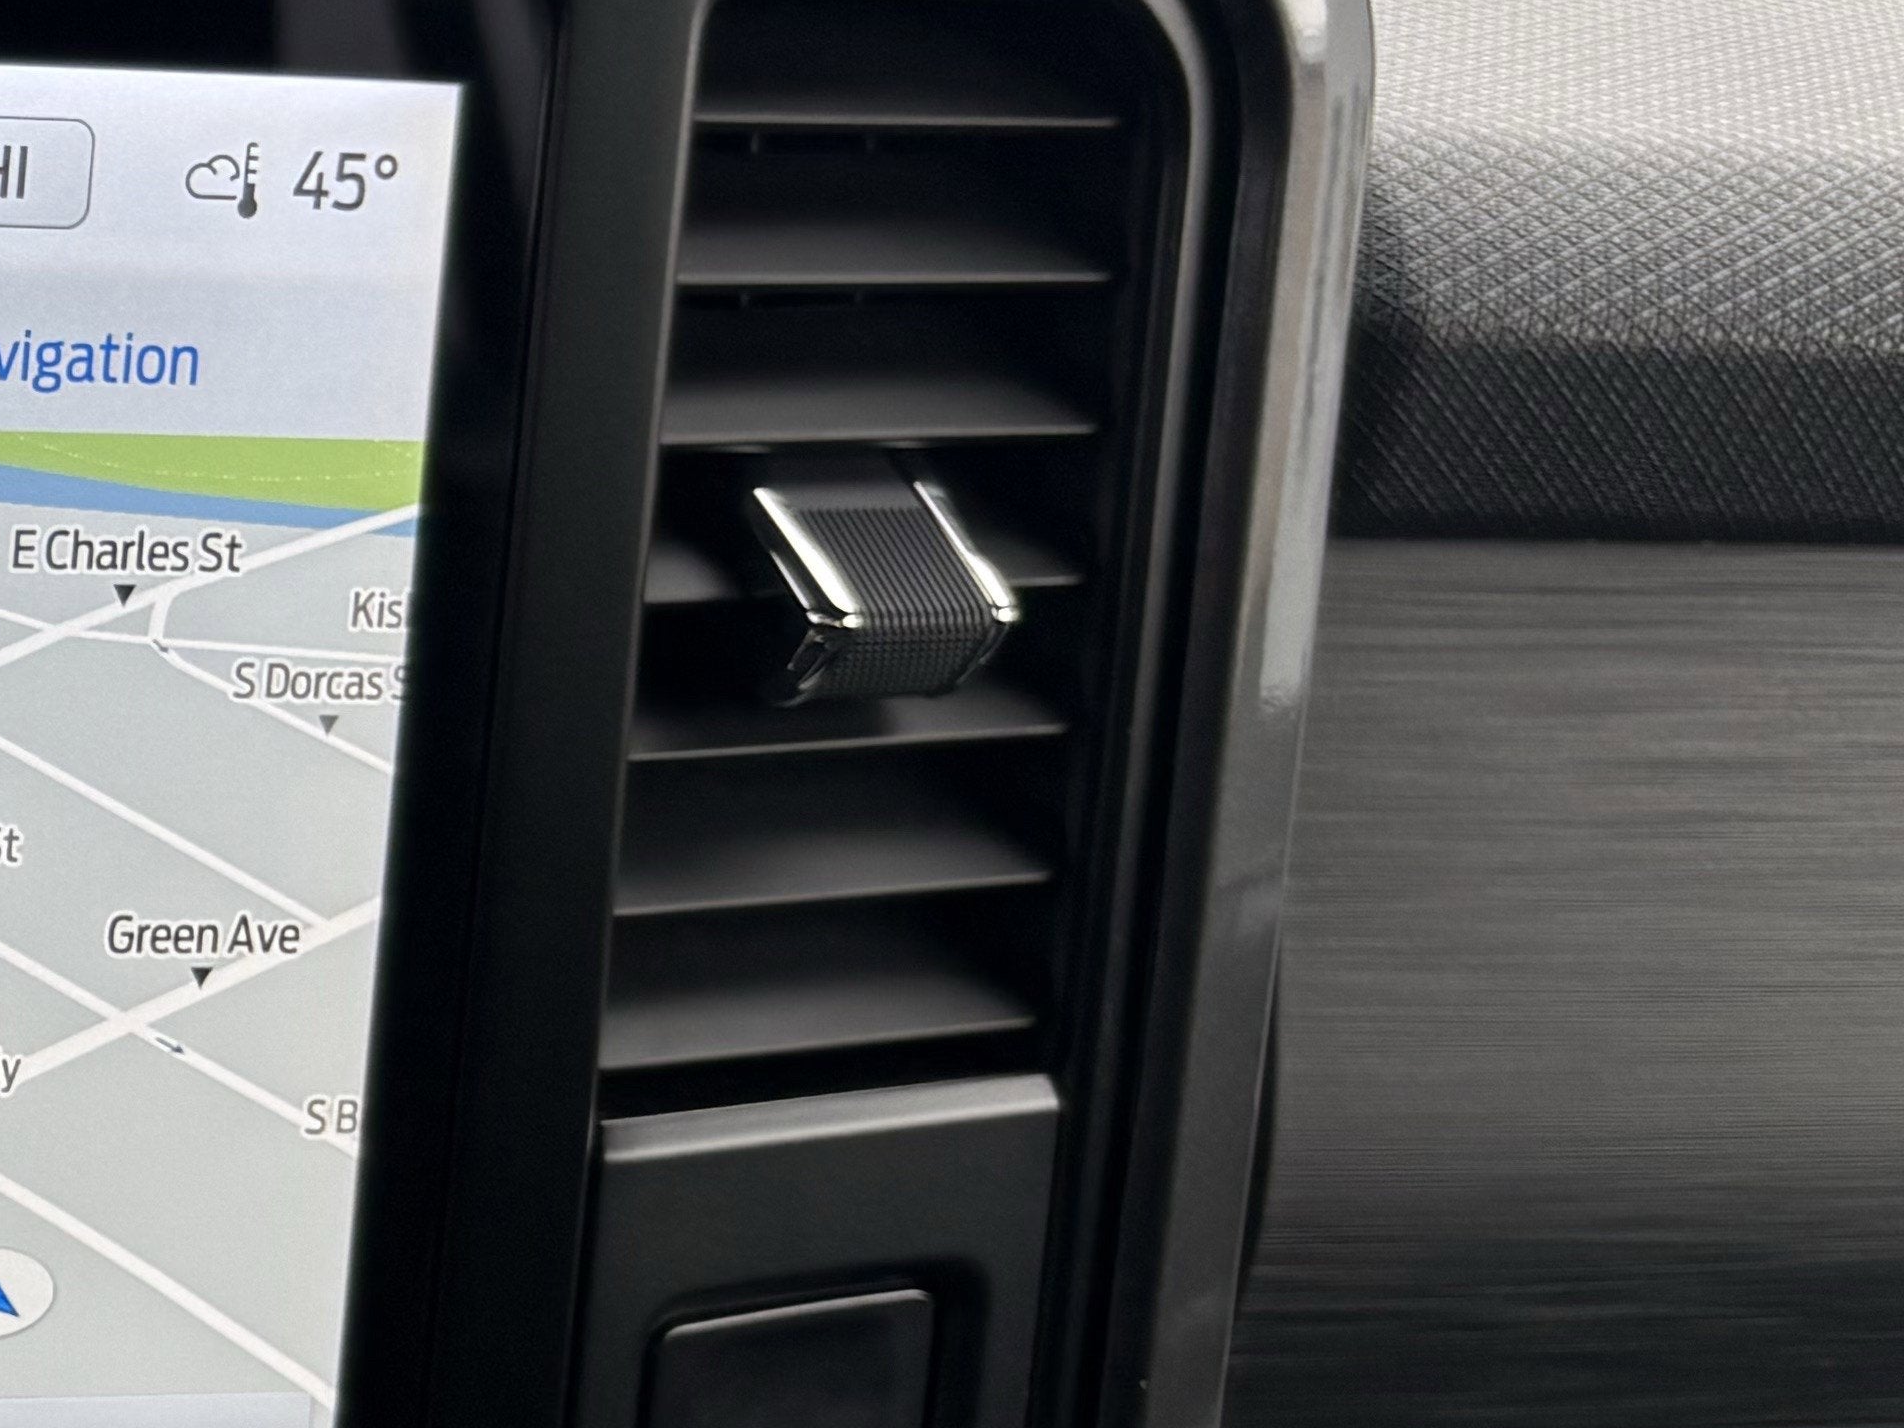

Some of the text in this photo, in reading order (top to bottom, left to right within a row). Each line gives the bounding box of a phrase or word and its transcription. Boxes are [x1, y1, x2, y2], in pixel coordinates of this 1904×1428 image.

[292, 150, 399, 212] 45°
[12, 528, 243, 573] E Charles St
[233, 663, 256, 699] S
[265, 663, 383, 700] Dorcas
[107, 914, 301, 956] Green Ave
[304, 1099, 358, 1135] S B
